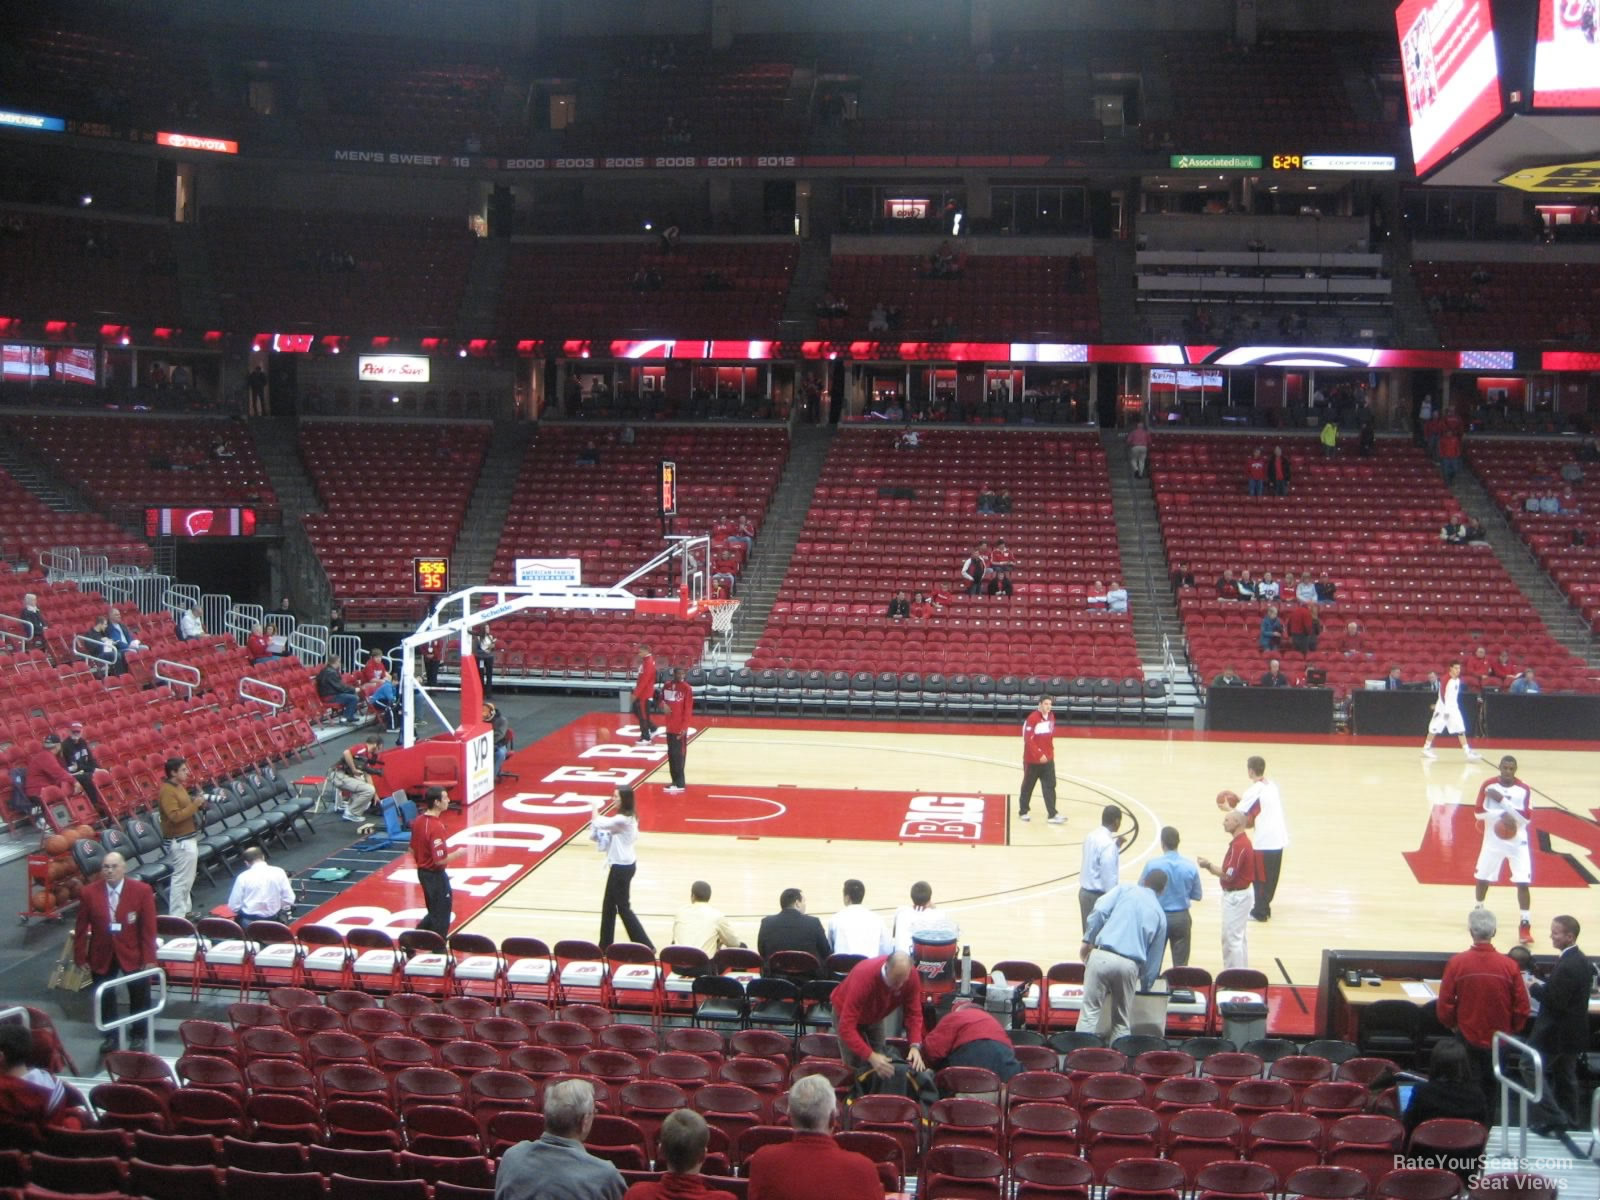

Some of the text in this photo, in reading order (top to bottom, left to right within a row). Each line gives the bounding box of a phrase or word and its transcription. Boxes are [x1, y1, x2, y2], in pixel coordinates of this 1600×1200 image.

[186, 137, 227, 151] TOYOTA
[335, 150, 795, 168] MEN'S SWEET 16 2000 2003 2005 2008 2011 2012
[1272, 155, 1300, 169] 6:29
[361, 363, 384, 375] Pick
[399, 364, 424, 375] Save
[424, 574, 441, 588] 35
